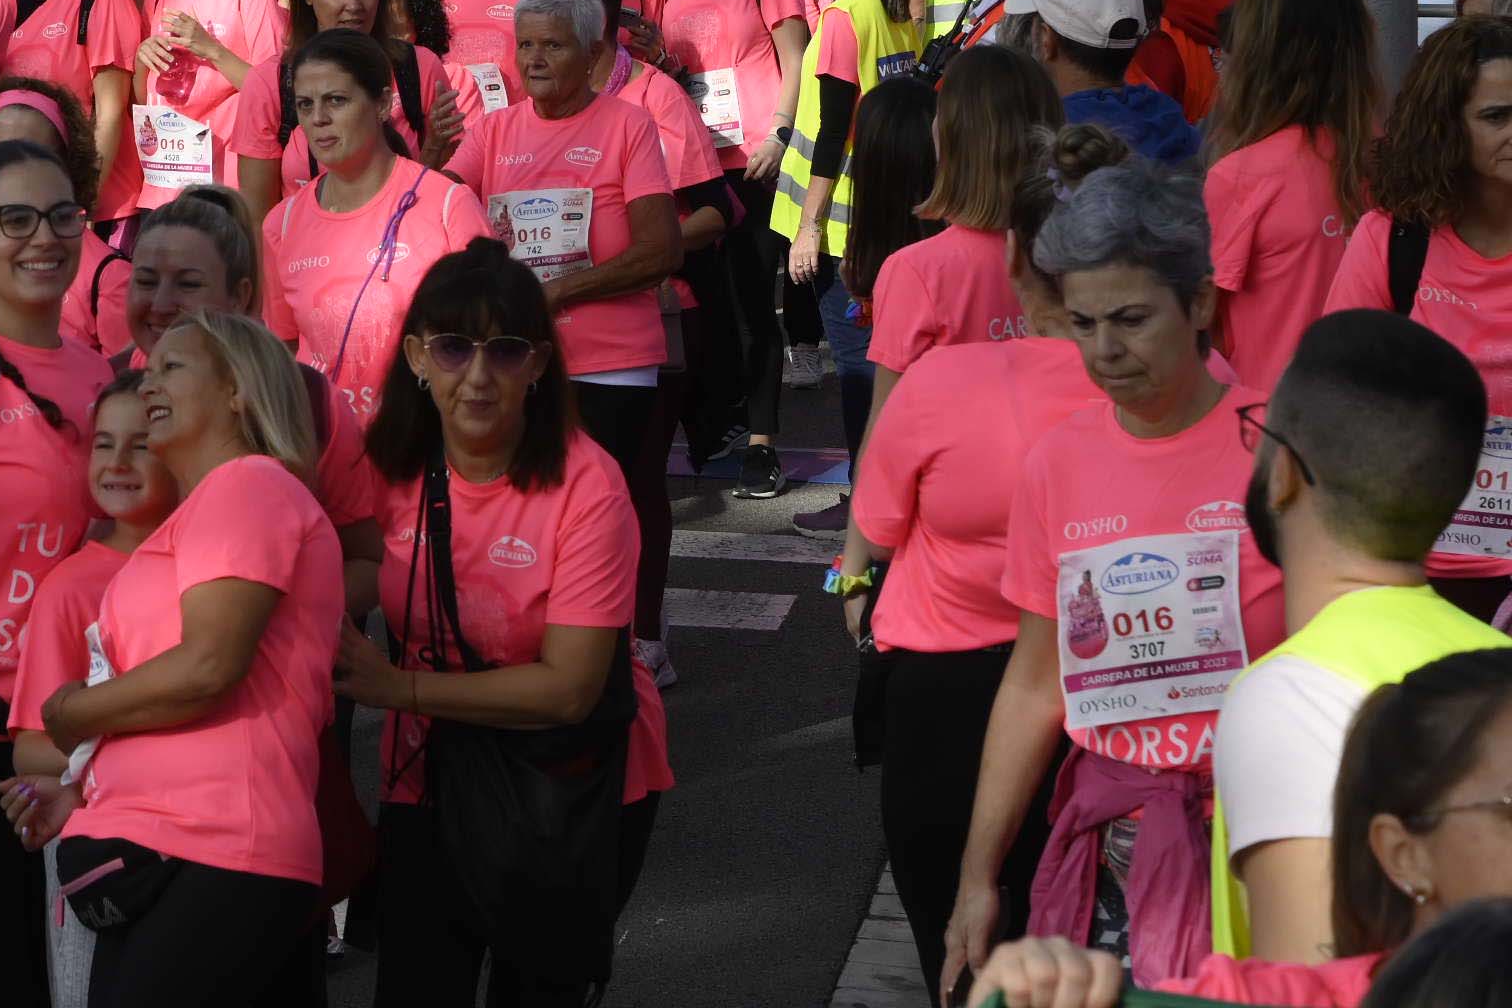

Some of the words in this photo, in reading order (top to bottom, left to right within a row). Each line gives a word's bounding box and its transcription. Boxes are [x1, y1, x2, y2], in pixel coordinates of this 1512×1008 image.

[160, 138, 185, 151] 016
[163, 154, 180, 162] 4528
[516, 205, 557, 217] ASTURIANA
[517, 226, 553, 243] 016
[526, 245, 542, 256] 742
[288, 255, 330, 273] OYSHO
[0, 401, 39, 425] OYS
[1064, 514, 1128, 541] OYSHO
[1191, 510, 1249, 529] ASTURIAN
[17, 522, 64, 558] TU
[1186, 553, 1224, 567] SUMA
[1105, 568, 1173, 588] ASTURIANA
[1112, 606, 1175, 637] 016
[1128, 641, 1166, 660] 3707
[1080, 669, 1133, 687] CARRERA
[1134, 667, 1148, 679] DE
[1149, 666, 1164, 677] LA
[1165, 661, 1200, 675] MUJER
[1202, 657, 1228, 670] 2023
[1079, 694, 1137, 715] OYSHO
[1182, 683, 1230, 699] Santande
